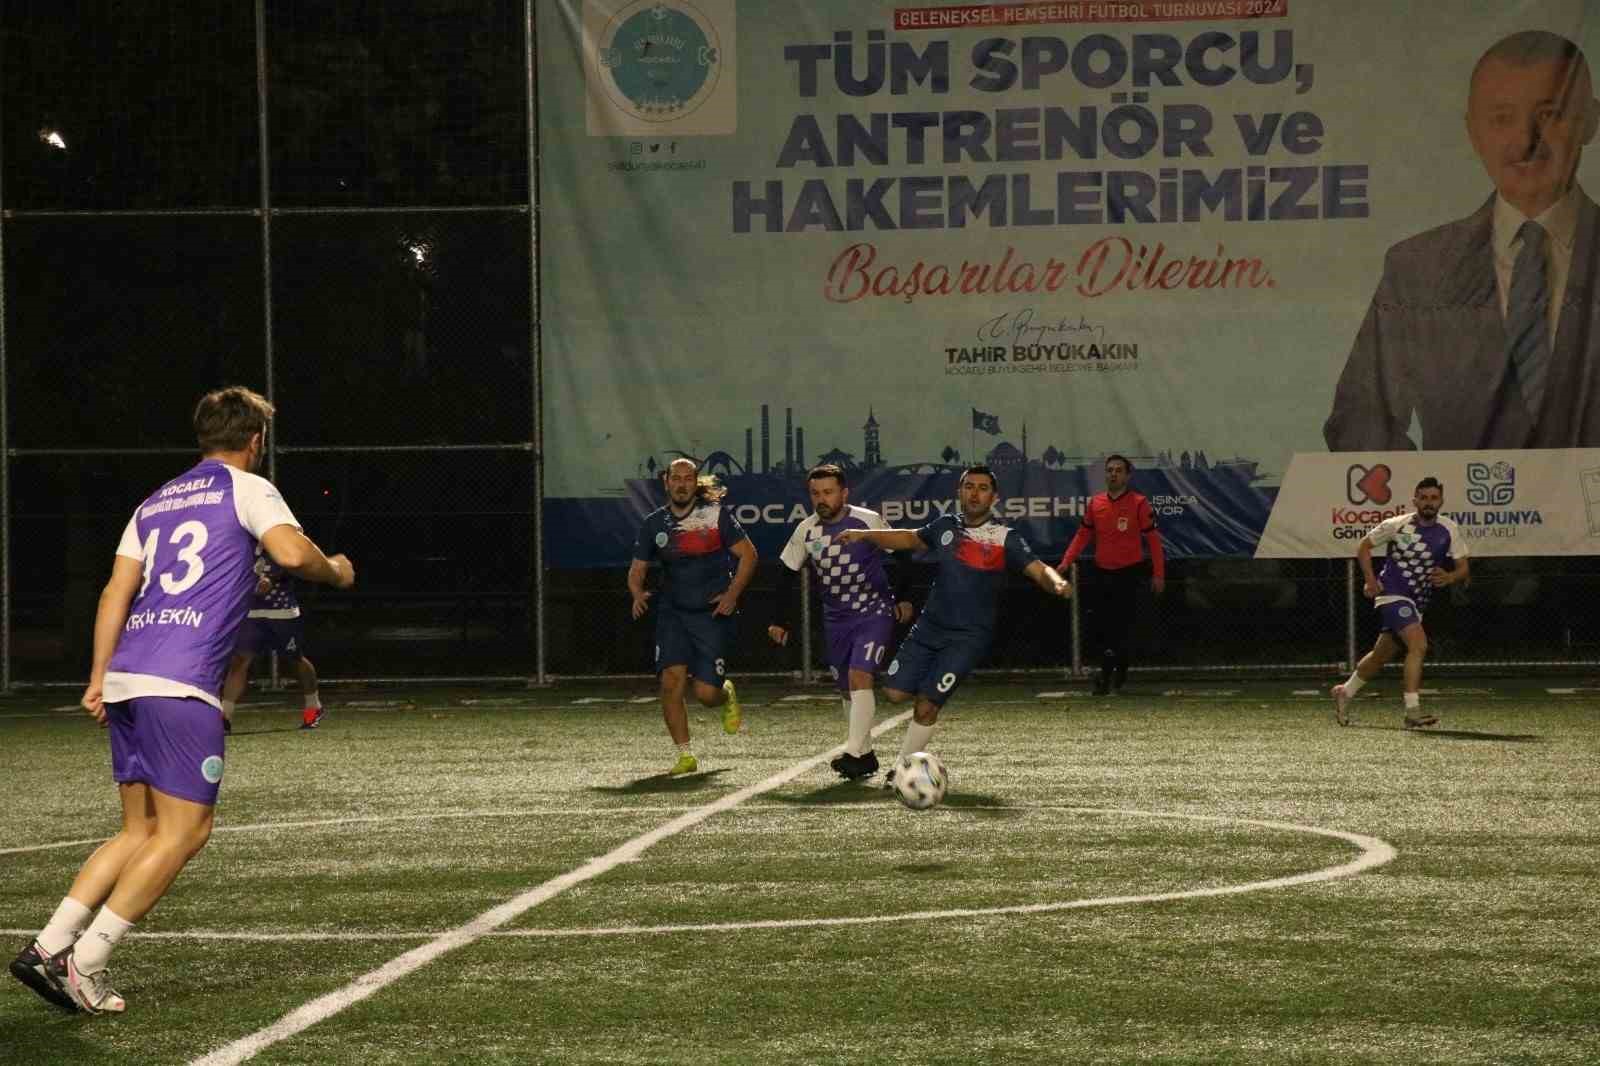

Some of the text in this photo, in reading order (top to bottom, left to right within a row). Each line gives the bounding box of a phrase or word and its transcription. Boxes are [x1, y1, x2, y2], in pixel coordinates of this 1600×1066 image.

[900, 9, 998, 26] GELENEKSEL
[1088, 4, 1148, 18] FUTBOL
[1154, 2, 1241, 17] TURNUVASI
[1247, 0, 1281, 14] 2024
[784, 30, 1315, 97] TÜM SPORCU,
[776, 92, 1325, 168] ANTRENÖR ve
[824, 236, 1278, 304] Başarılar Dilerim.
[945, 343, 1138, 364] TAHİR BÜYÜKAKIN
[726, 504, 809, 524] OCA
[1152, 505, 1184, 515] YOR
[137, 520, 208, 598] 13
[157, 606, 203, 628] EKİN
[864, 641, 885, 665] 10
[937, 672, 956, 692] 9
